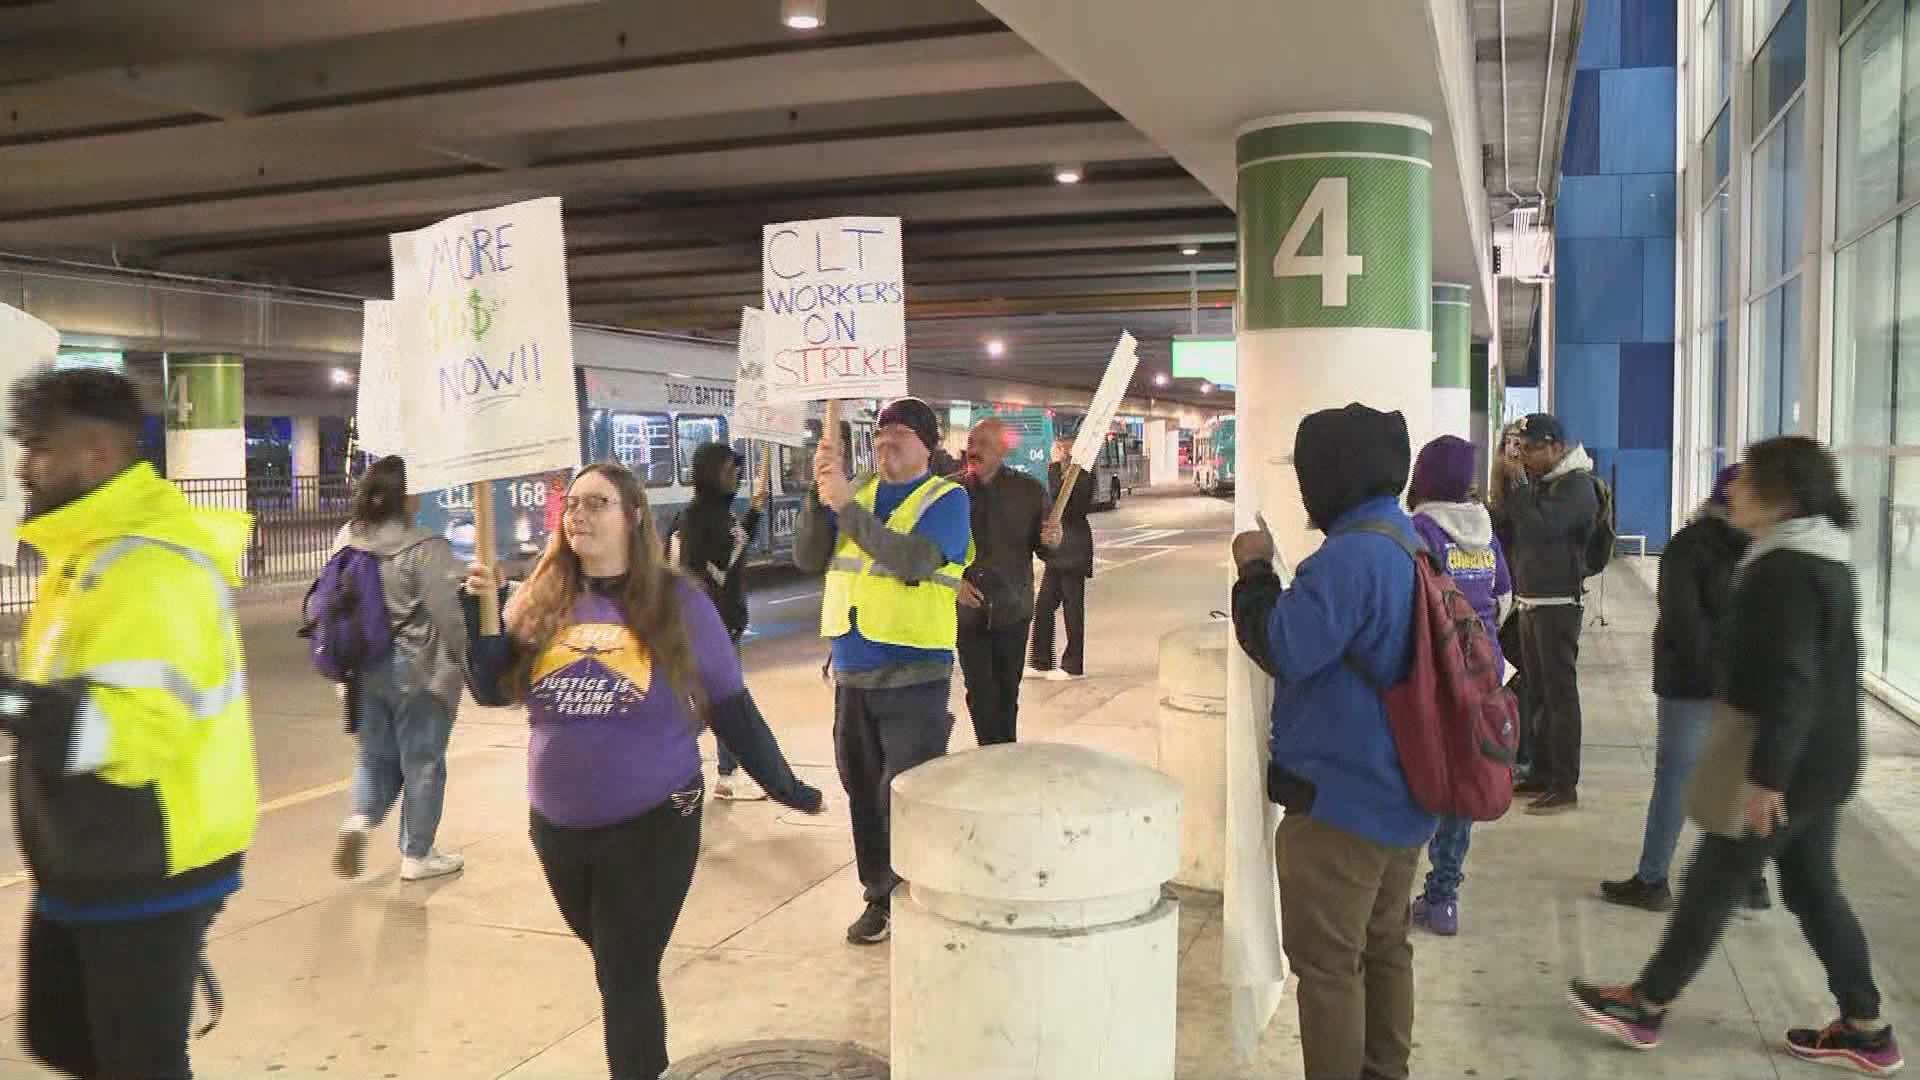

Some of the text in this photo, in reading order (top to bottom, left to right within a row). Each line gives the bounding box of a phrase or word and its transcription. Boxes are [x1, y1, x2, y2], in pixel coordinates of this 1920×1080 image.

[427, 223, 513, 293] MORE
[768, 229, 883, 279] CLT
[1273, 177, 1362, 306] 4
[767, 282, 901, 314] WORKERS
[803, 311, 855, 344] ON
[439, 342, 541, 410] NOW!!
[775, 346, 904, 383] STRIKE!
[508, 481, 545, 508] 168
[541, 677, 630, 692] JUSTICE IS
[556, 691, 614, 703] TAKING
[558, 703, 614, 715] FLIGHT
